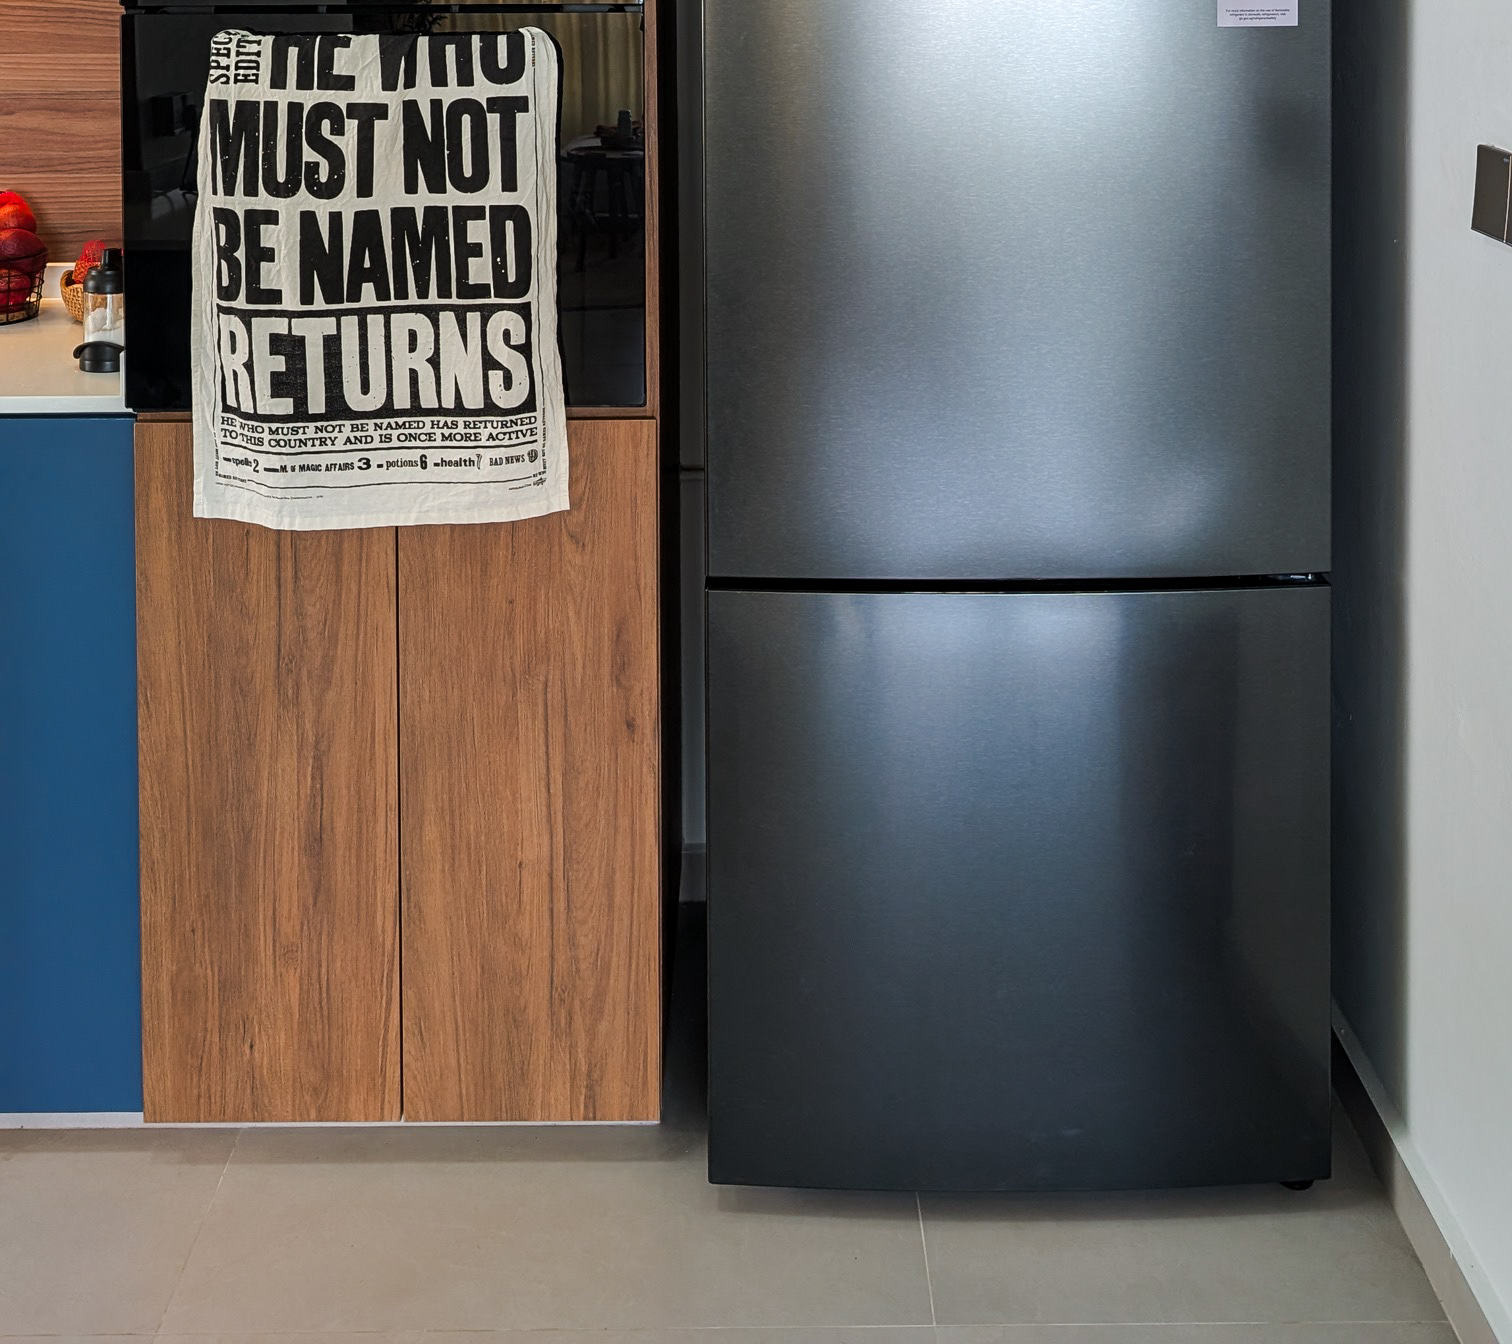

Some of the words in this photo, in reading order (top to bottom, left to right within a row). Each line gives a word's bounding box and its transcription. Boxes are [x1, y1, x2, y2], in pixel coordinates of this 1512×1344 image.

[233, 35, 262, 85] EDIT
[209, 99, 389, 200] MUST
[402, 95, 529, 195] NOT
[212, 206, 282, 305] BE
[299, 205, 532, 305] NAMED
[218, 310, 530, 415] RETURNS
[221, 416, 237, 427] HE
[238, 420, 265, 434] WHO
[268, 425, 309, 436] MUST
[314, 424, 345, 434] NOT
[350, 423, 369, 433] BE
[373, 420, 425, 431] NAMED
[430, 420, 459, 429] HAS
[463, 415, 537, 429] RETURNED
[221, 428, 238, 439] TO
[240, 433, 264, 447] THIS
[268, 436, 338, 448] COUNTRY
[343, 435, 374, 445] AND
[378, 433, 392, 443] IS
[397, 432, 437, 442] ONCE
[440, 432, 482, 442] MORE
[486, 427, 538, 442] ACTIVE
[253, 458, 259, 473] 2
[298, 464, 322, 472] MAGIC
[325, 462, 355, 472] AFFAIRS
[357, 457, 372, 471] 3
[386, 457, 418, 470] potions
[419, 454, 428, 470] 6
[441, 457, 475, 467] health
[489, 457, 503, 466] BAD
[505, 454, 526, 465] NEWS
